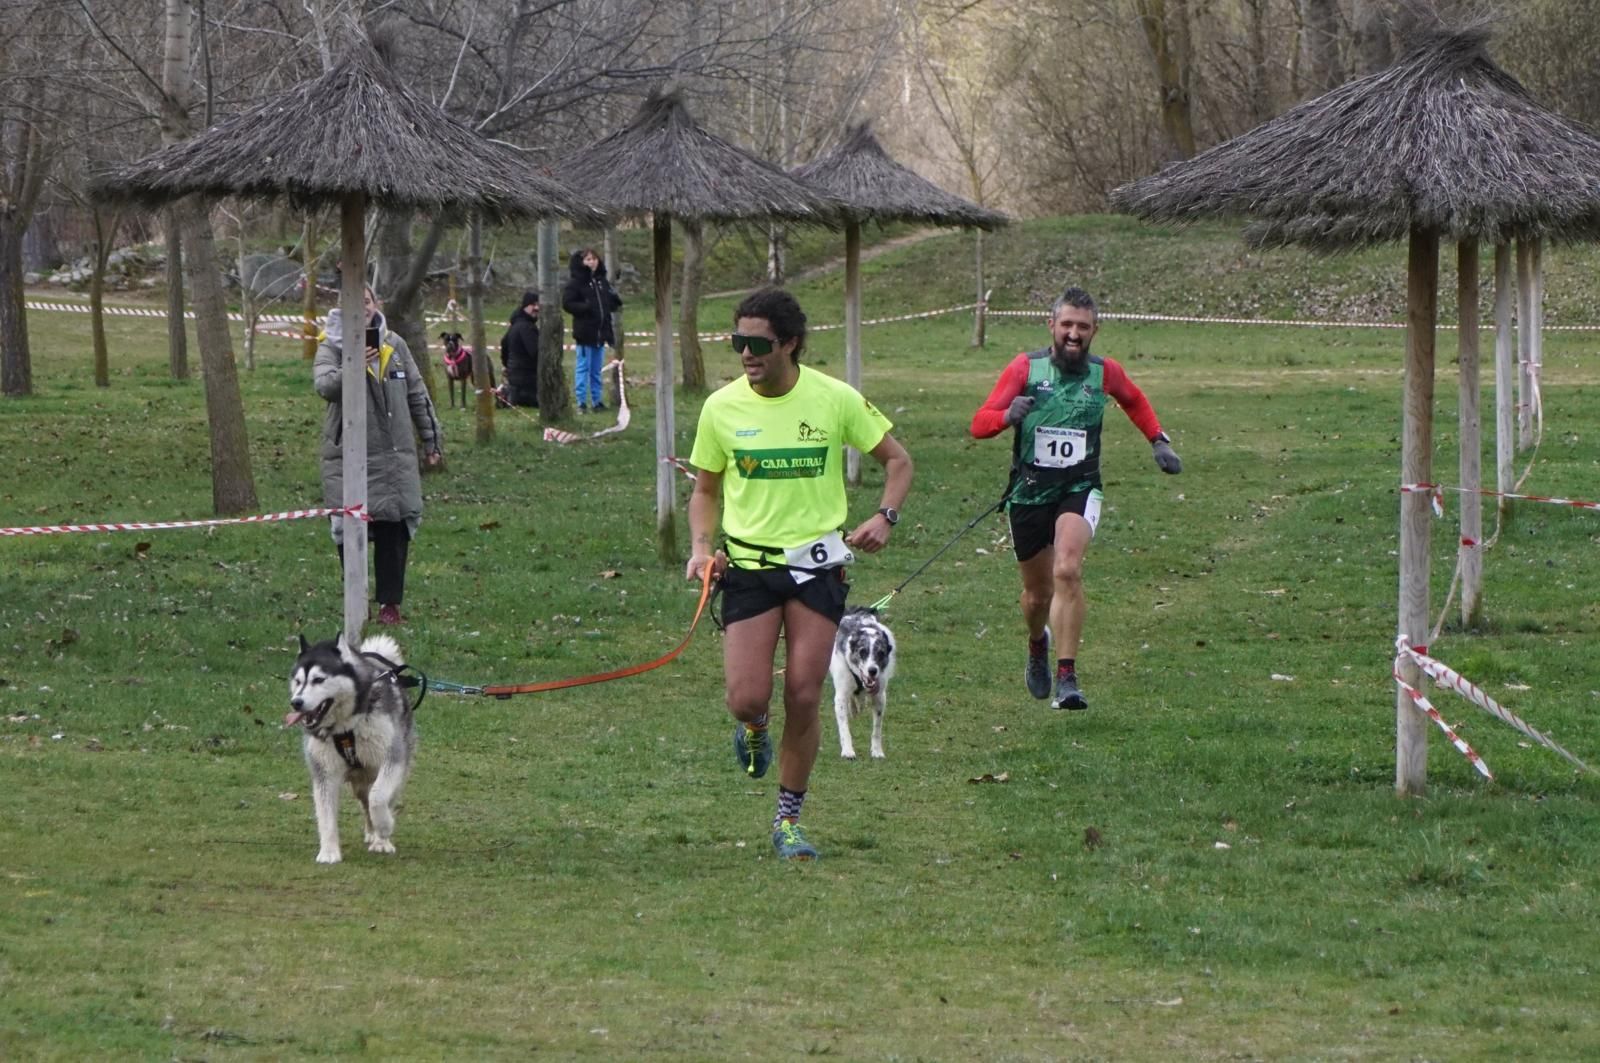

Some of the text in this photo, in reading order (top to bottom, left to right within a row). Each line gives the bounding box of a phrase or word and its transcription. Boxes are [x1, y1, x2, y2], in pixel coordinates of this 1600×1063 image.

[1047, 440, 1073, 458] 10
[761, 457, 824, 469] CAJA RURAL
[810, 542, 828, 564] 6
